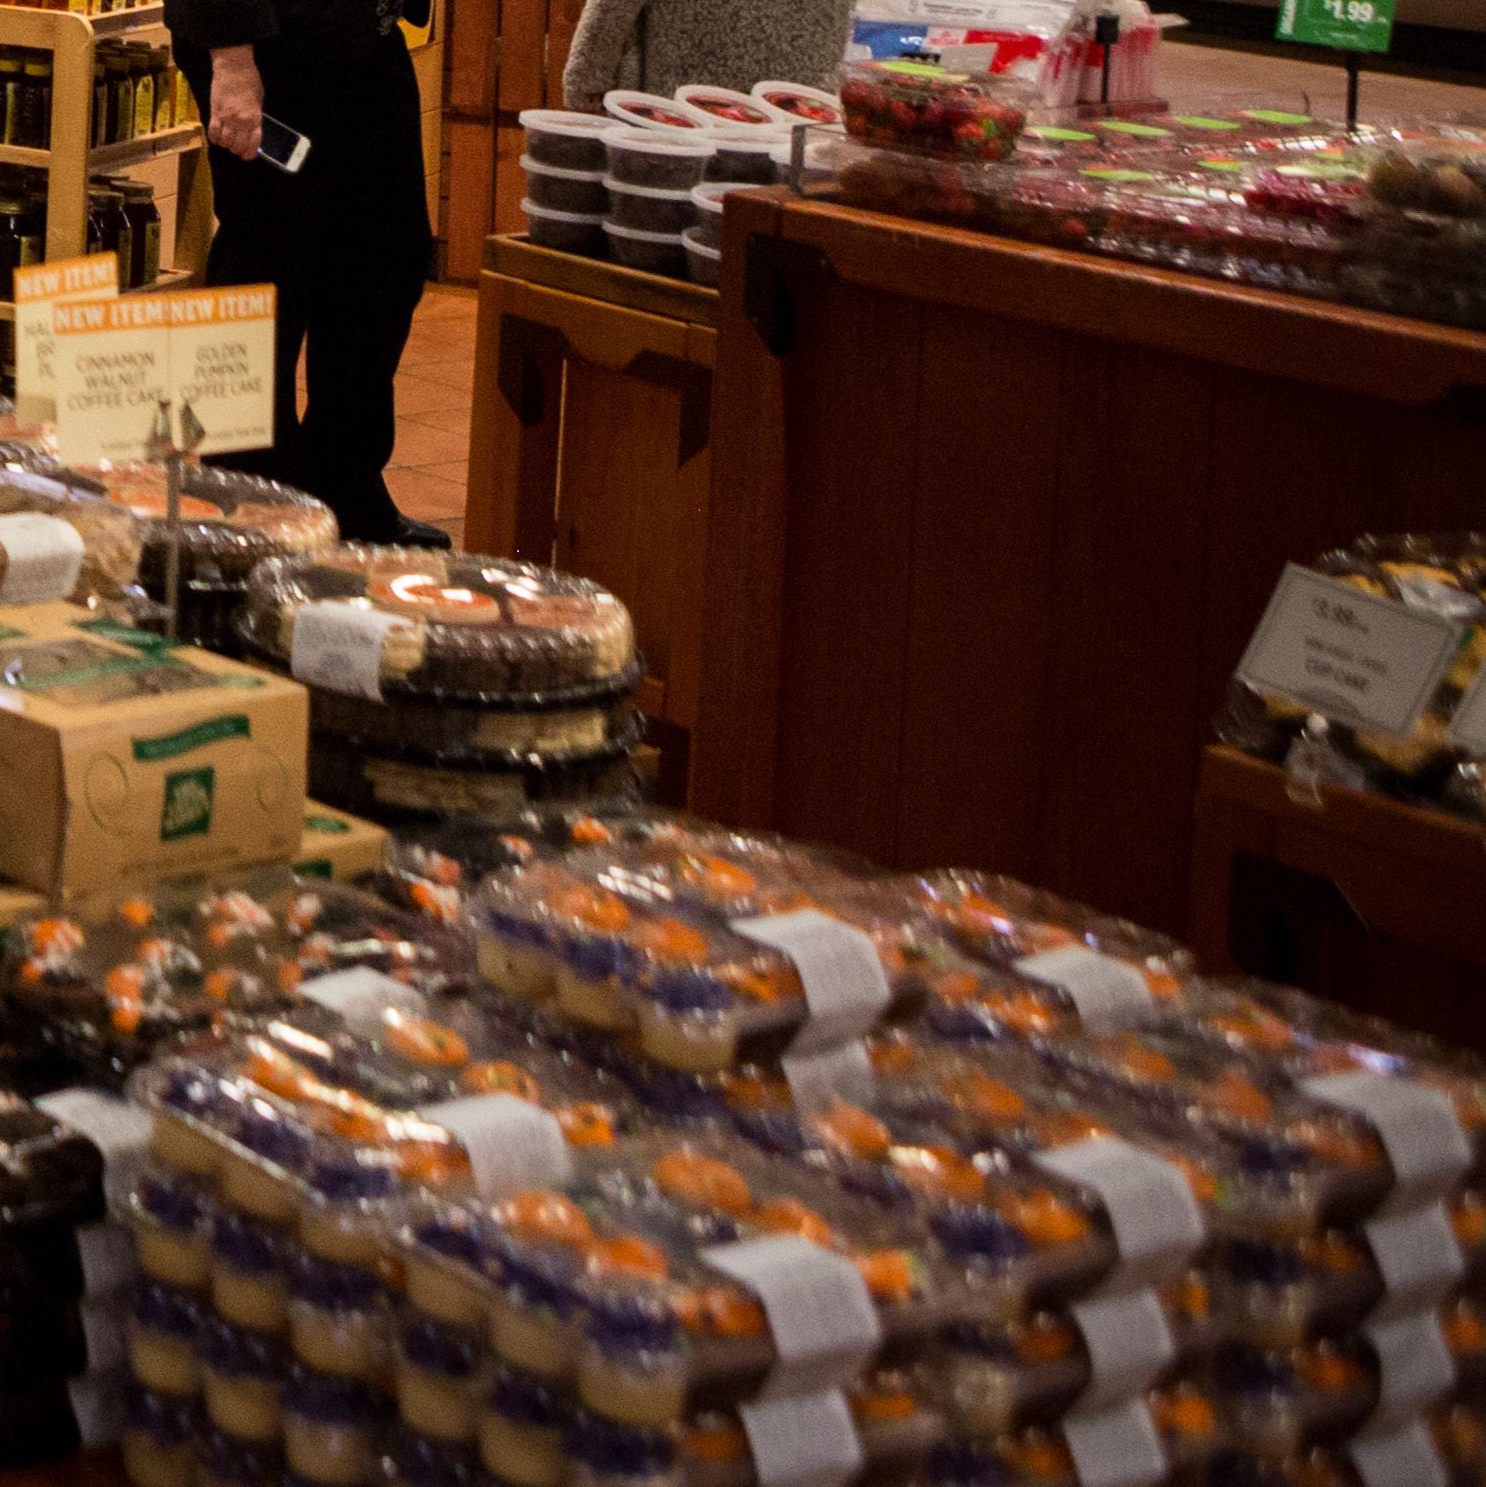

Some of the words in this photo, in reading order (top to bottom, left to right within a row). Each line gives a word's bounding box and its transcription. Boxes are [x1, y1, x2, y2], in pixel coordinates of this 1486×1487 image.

[17, 271, 61, 298] NEW
[65, 261, 116, 290] ITEM!
[54, 302, 106, 330] NEW
[170, 297, 215, 322] NEW
[219, 290, 274, 318] ITEM!
[77, 351, 156, 372] CINNAMON
[195, 342, 249, 362] GOLDEN
[84, 370, 146, 391] WALNUT
[230, 377, 264, 397] CAKE
[67, 391, 124, 412] COFFEE
